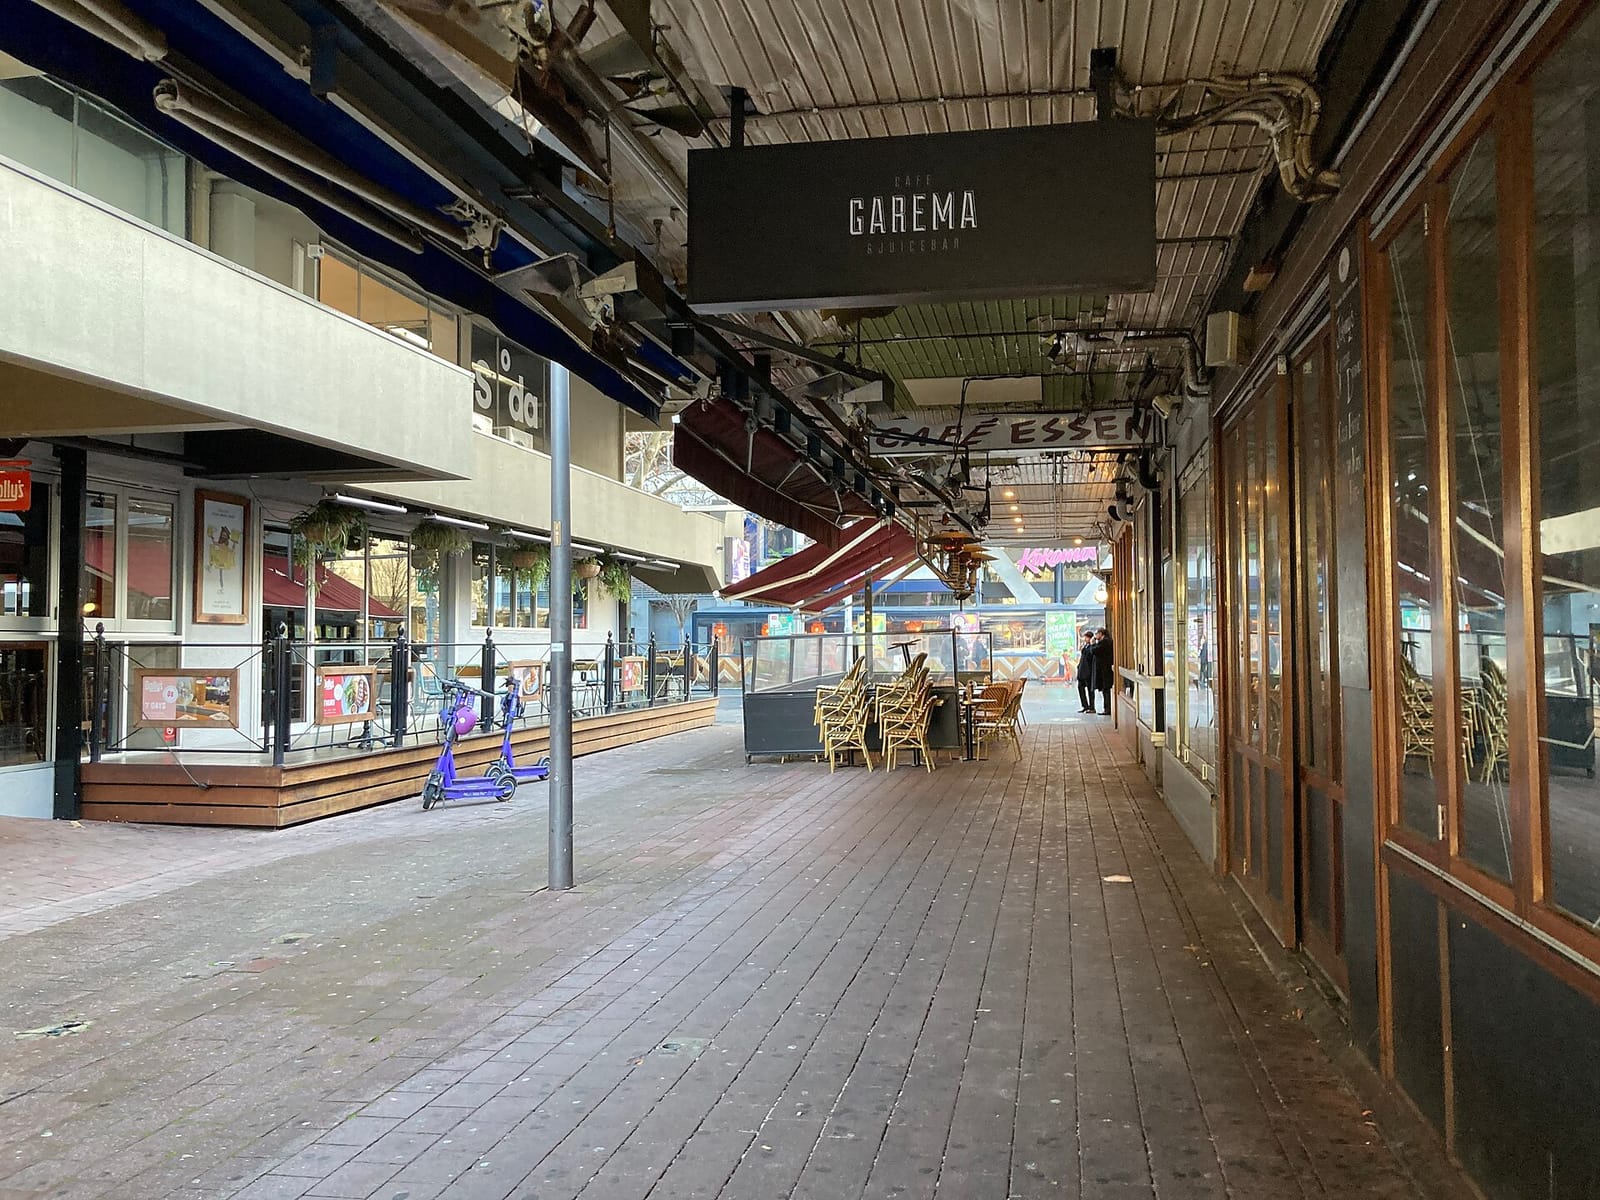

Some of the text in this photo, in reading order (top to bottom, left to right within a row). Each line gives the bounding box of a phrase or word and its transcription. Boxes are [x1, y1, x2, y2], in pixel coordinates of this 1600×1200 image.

[894, 174, 931, 187] CAFE
[848, 189, 979, 237] GAREMA
[1009, 414, 1153, 446] ESSEN
